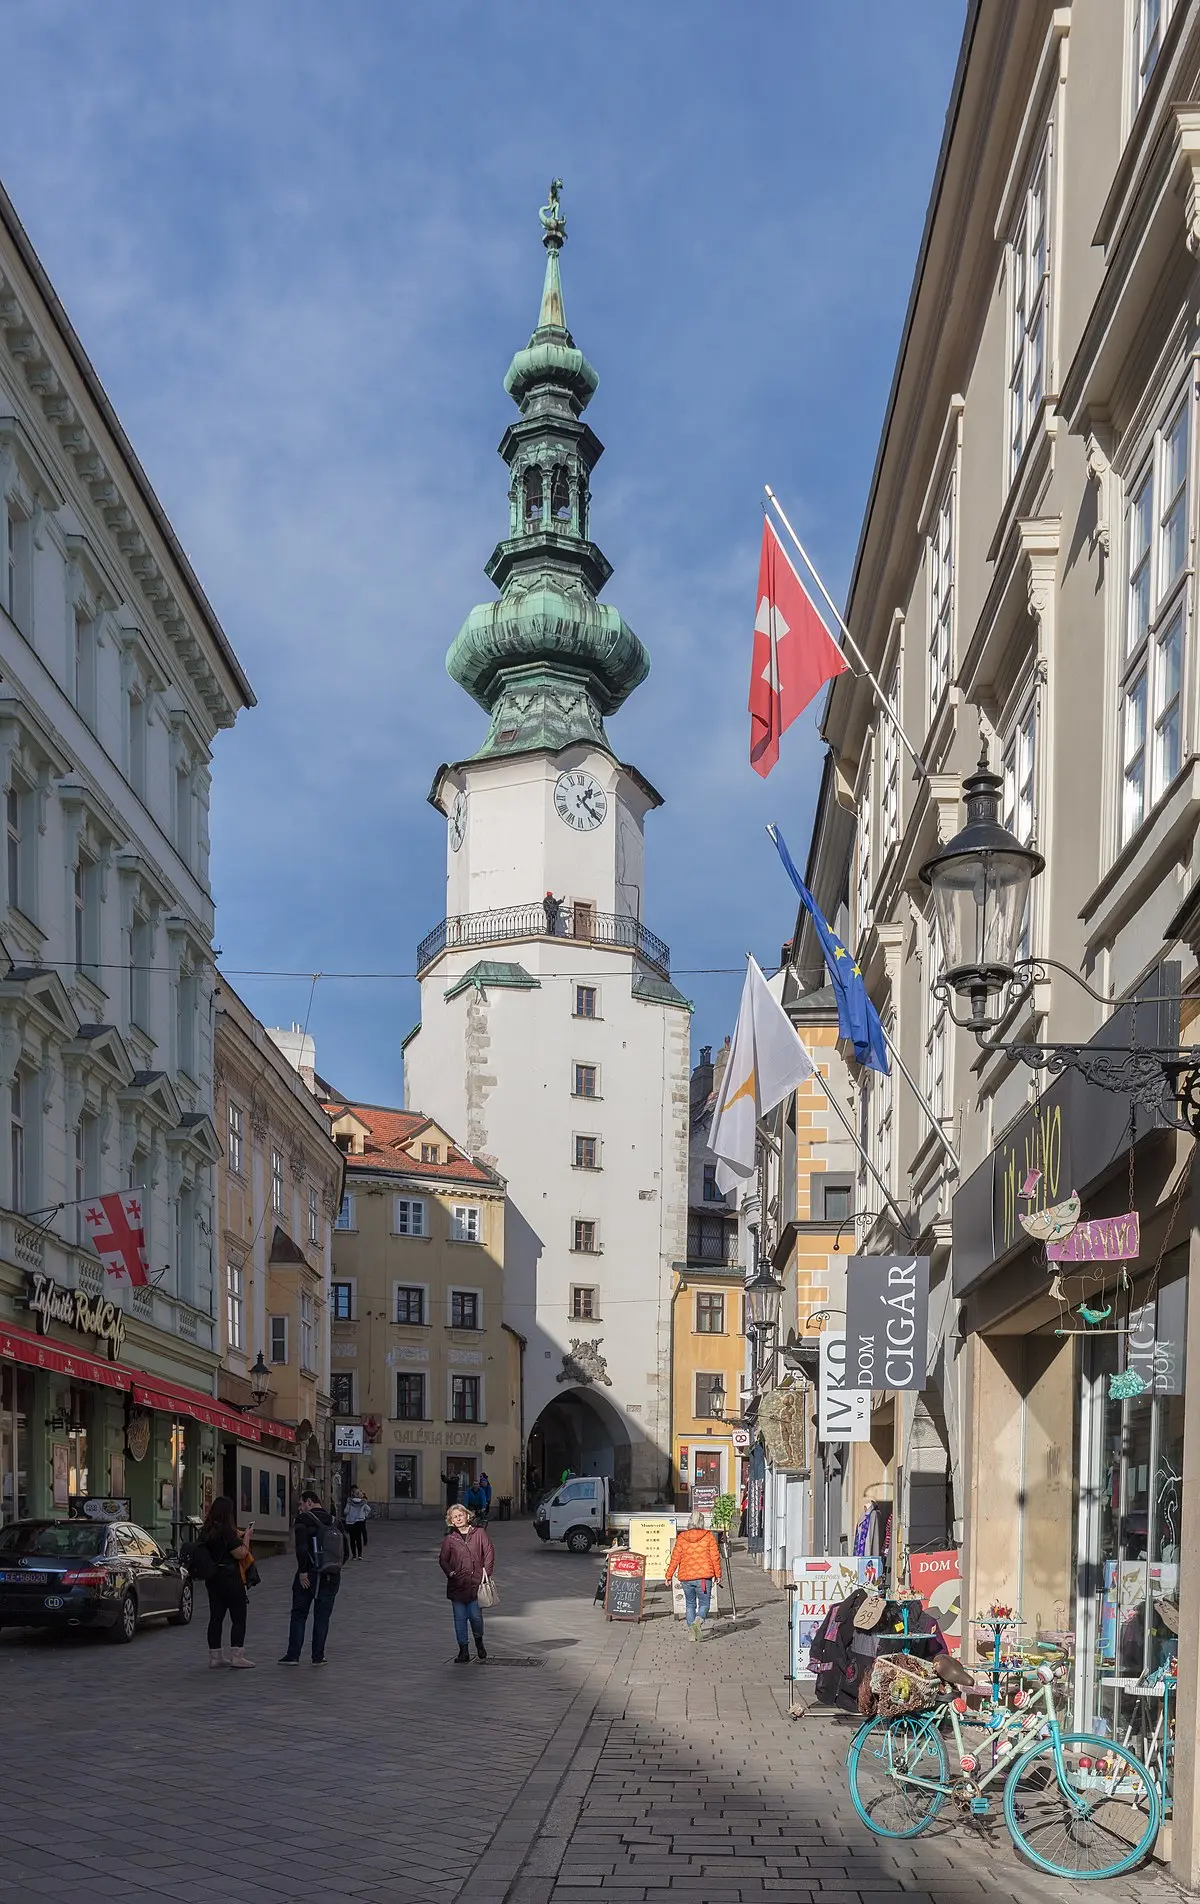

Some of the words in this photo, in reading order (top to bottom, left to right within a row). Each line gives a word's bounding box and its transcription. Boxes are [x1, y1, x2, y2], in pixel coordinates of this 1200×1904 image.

[880, 1260, 917, 1387] CIGÁR
[858, 1335, 875, 1386] DOM
[827, 1339, 852, 1433] IVKO
[337, 1438, 361, 1447] DELIA
[446, 1431, 477, 1447] NOVA
[919, 1560, 951, 1573] DOM
[48, 1599, 60, 1607] CD
